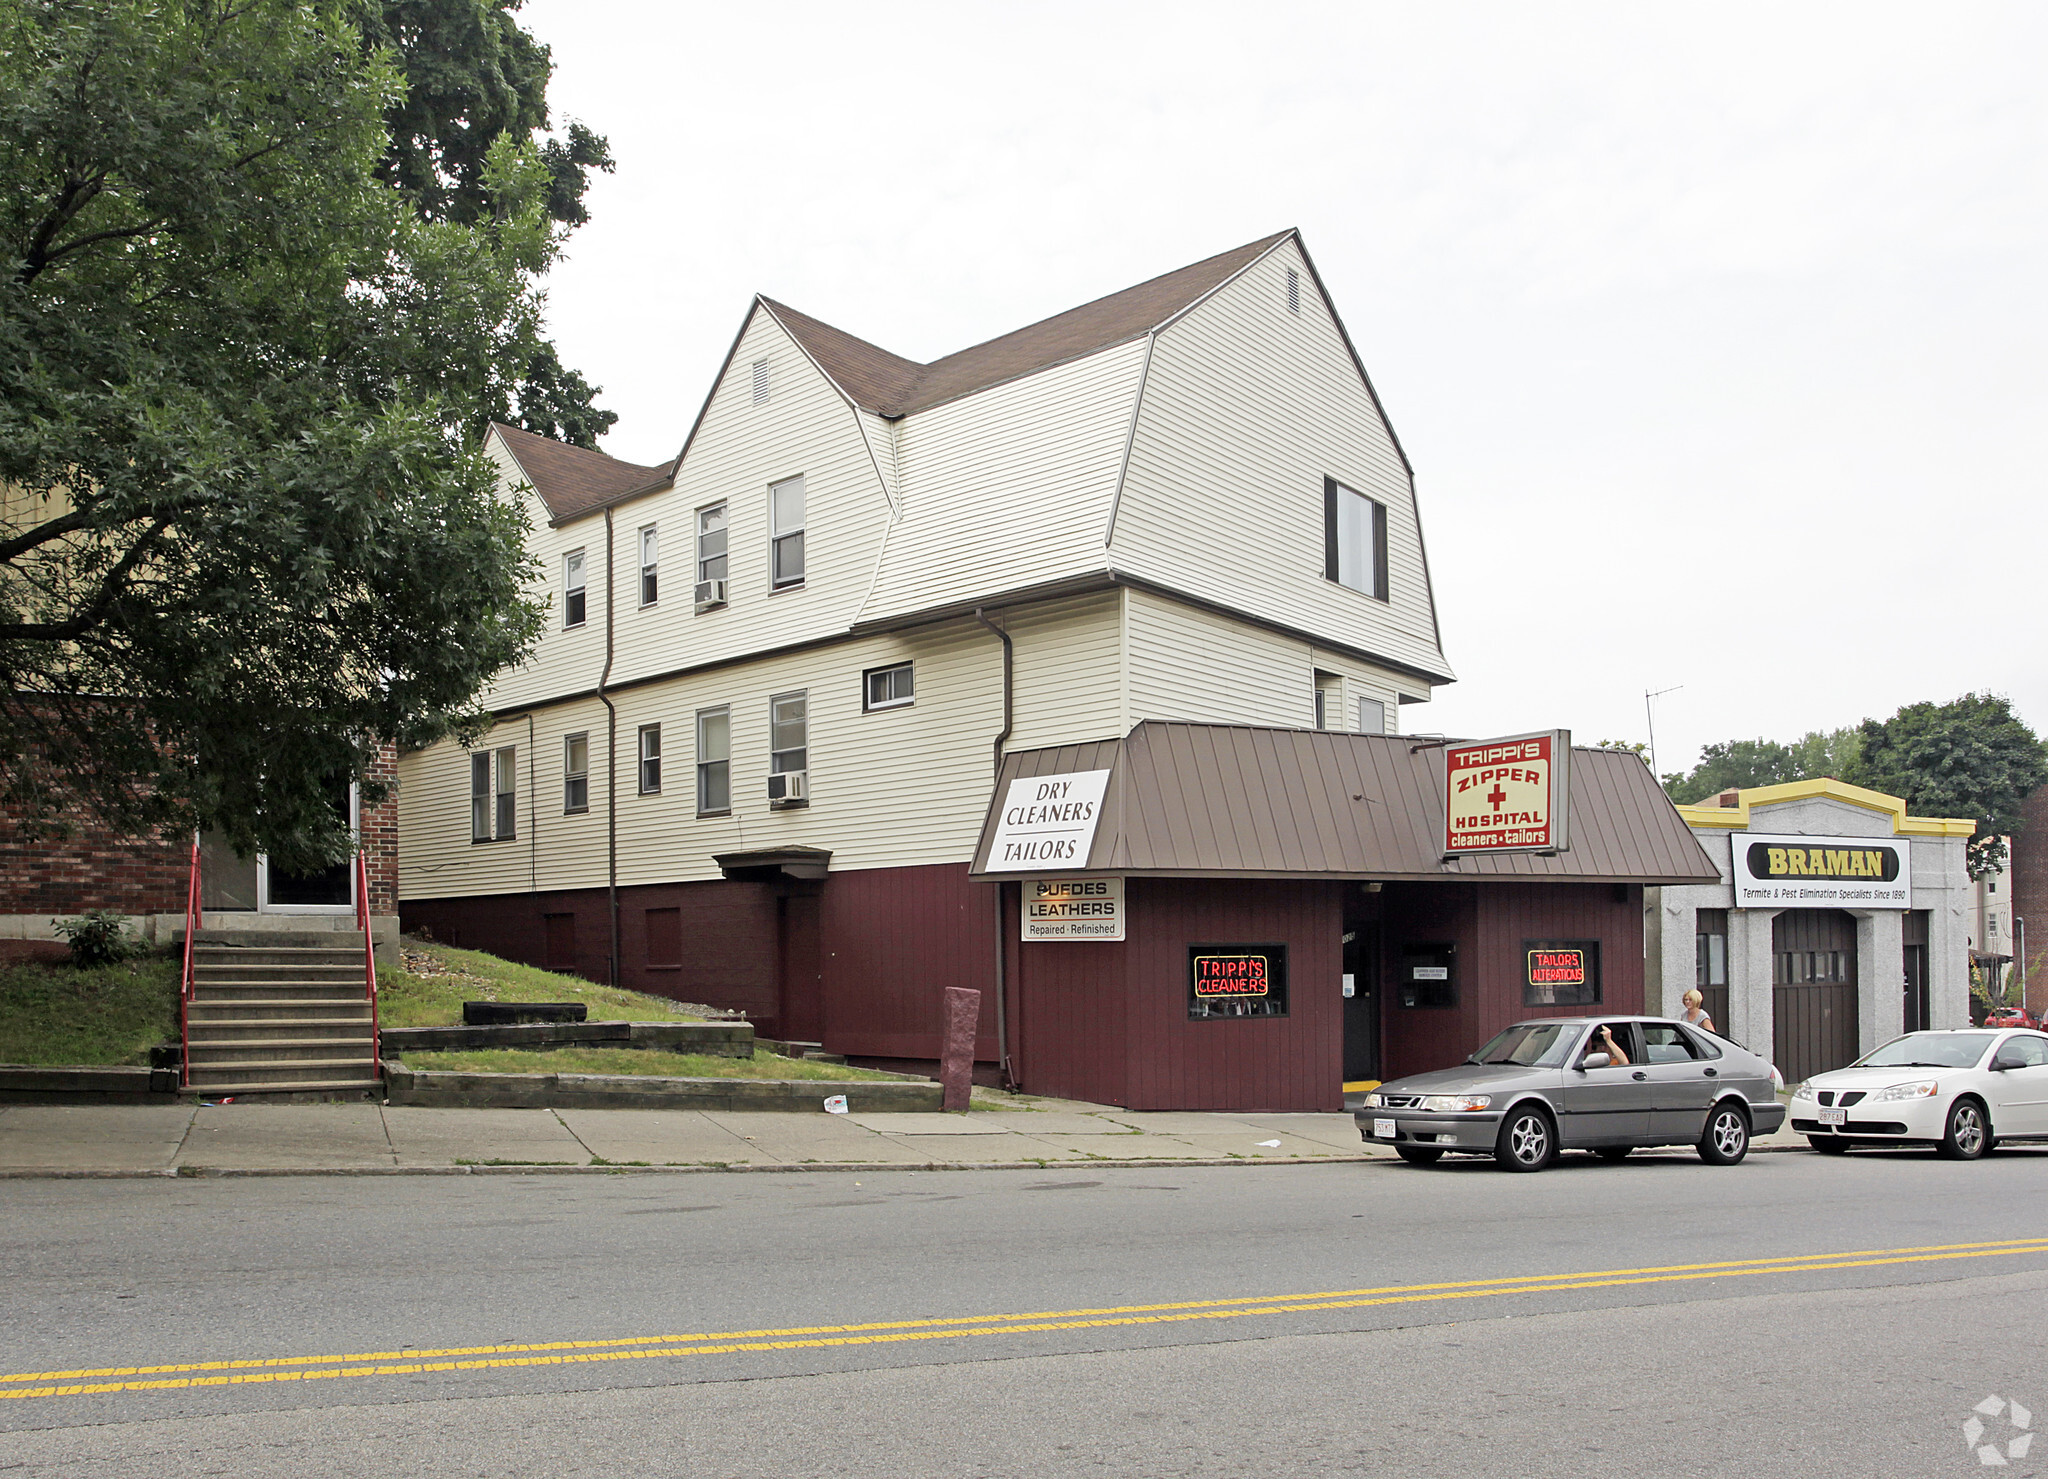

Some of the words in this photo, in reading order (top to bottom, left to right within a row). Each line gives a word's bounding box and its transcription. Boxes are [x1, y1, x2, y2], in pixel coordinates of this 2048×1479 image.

[1455, 743, 1540, 766] TRIPPI'S
[1457, 768, 1540, 793] ZIPPER
[1036, 781, 1072, 801] DRY
[1007, 801, 1094, 826] CLEANERS
[1456, 811, 1543, 829] HOSPITAL
[1451, 833, 1497, 847] cleaners
[1504, 829, 1545, 845] tailors
[1004, 839, 1077, 861] TAILORS
[1767, 848, 1883, 877] BRAMAN
[1743, 888, 1771, 899] Termite
[1774, 889, 1779, 899] &
[1781, 888, 1797, 899] Pest
[1799, 888, 1837, 899] Elimination
[1839, 889, 1872, 900] Specialists
[1874, 890, 1890, 900] Since
[1891, 890, 1906, 900] 1890
[1030, 902, 1115, 917] LEATHERS
[1030, 925, 1065, 936] Repaired
[1071, 924, 1115, 934] Refinished
[1201, 959, 1263, 977] TRIPPI'S
[1535, 954, 1579, 966] TAILORS
[1532, 968, 1584, 981] ALTERATIONS
[1198, 977, 1268, 993] CLEANERS
